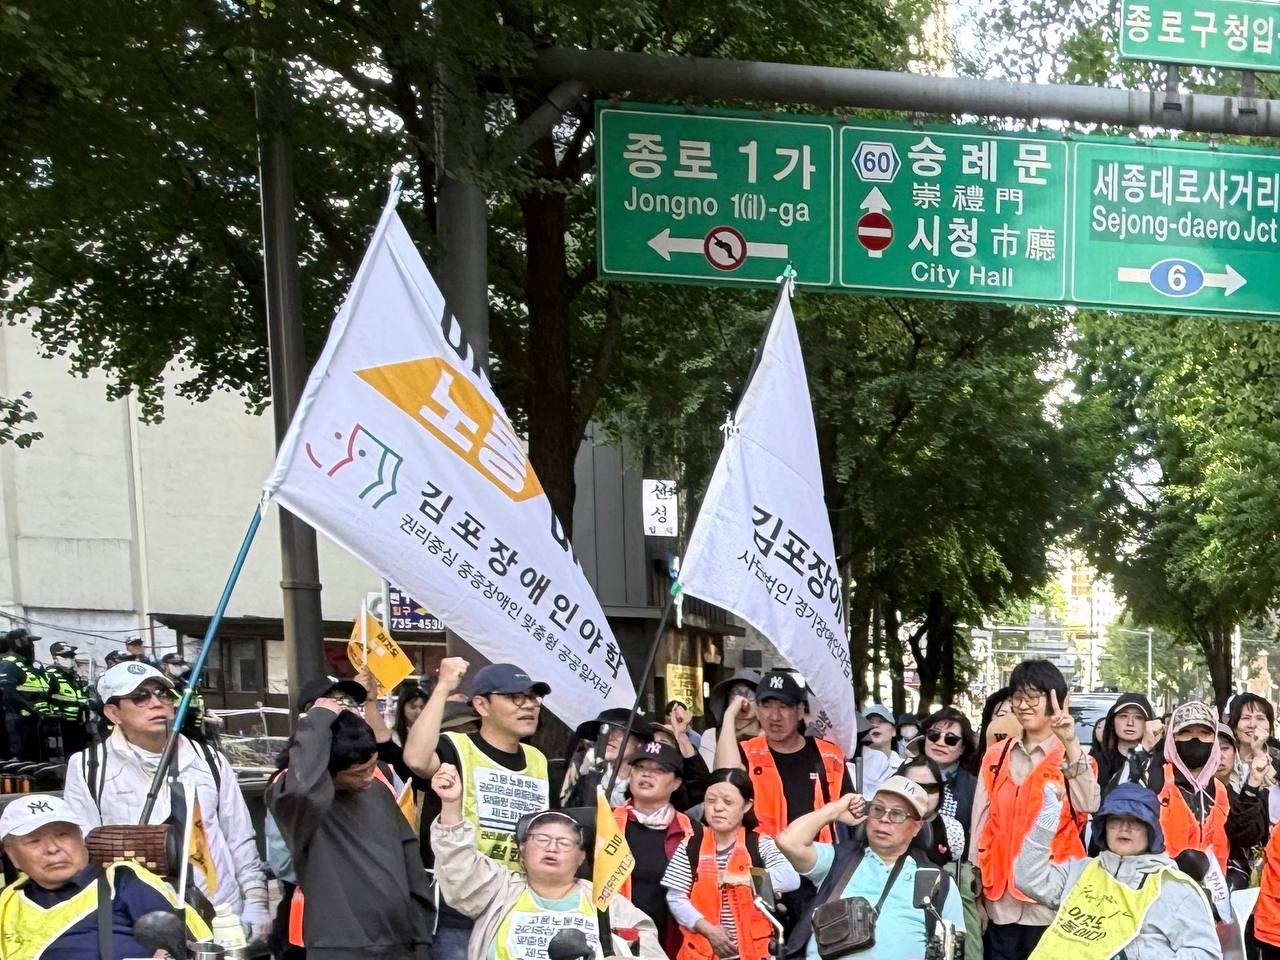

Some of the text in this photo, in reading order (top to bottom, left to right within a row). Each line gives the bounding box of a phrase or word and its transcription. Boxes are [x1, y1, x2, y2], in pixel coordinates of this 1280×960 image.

[623, 132, 816, 190] 종로 1가
[863, 151, 891, 174] 60
[908, 136, 1051, 184] 숭례문
[624, 186, 810, 227] Jongno 1(il)-ga
[1093, 162, 1280, 213] 세종대로사거리
[908, 215, 978, 258] 시청
[1092, 204, 1278, 243] Sejong-daero Jct
[911, 261, 1013, 288] City Hall
[1167, 264, 1187, 291] 6
[418, 481, 624, 680] 김포장애인야학
[400, 513, 459, 568] 권리중심
[558, 645, 612, 700] 공공일자리
